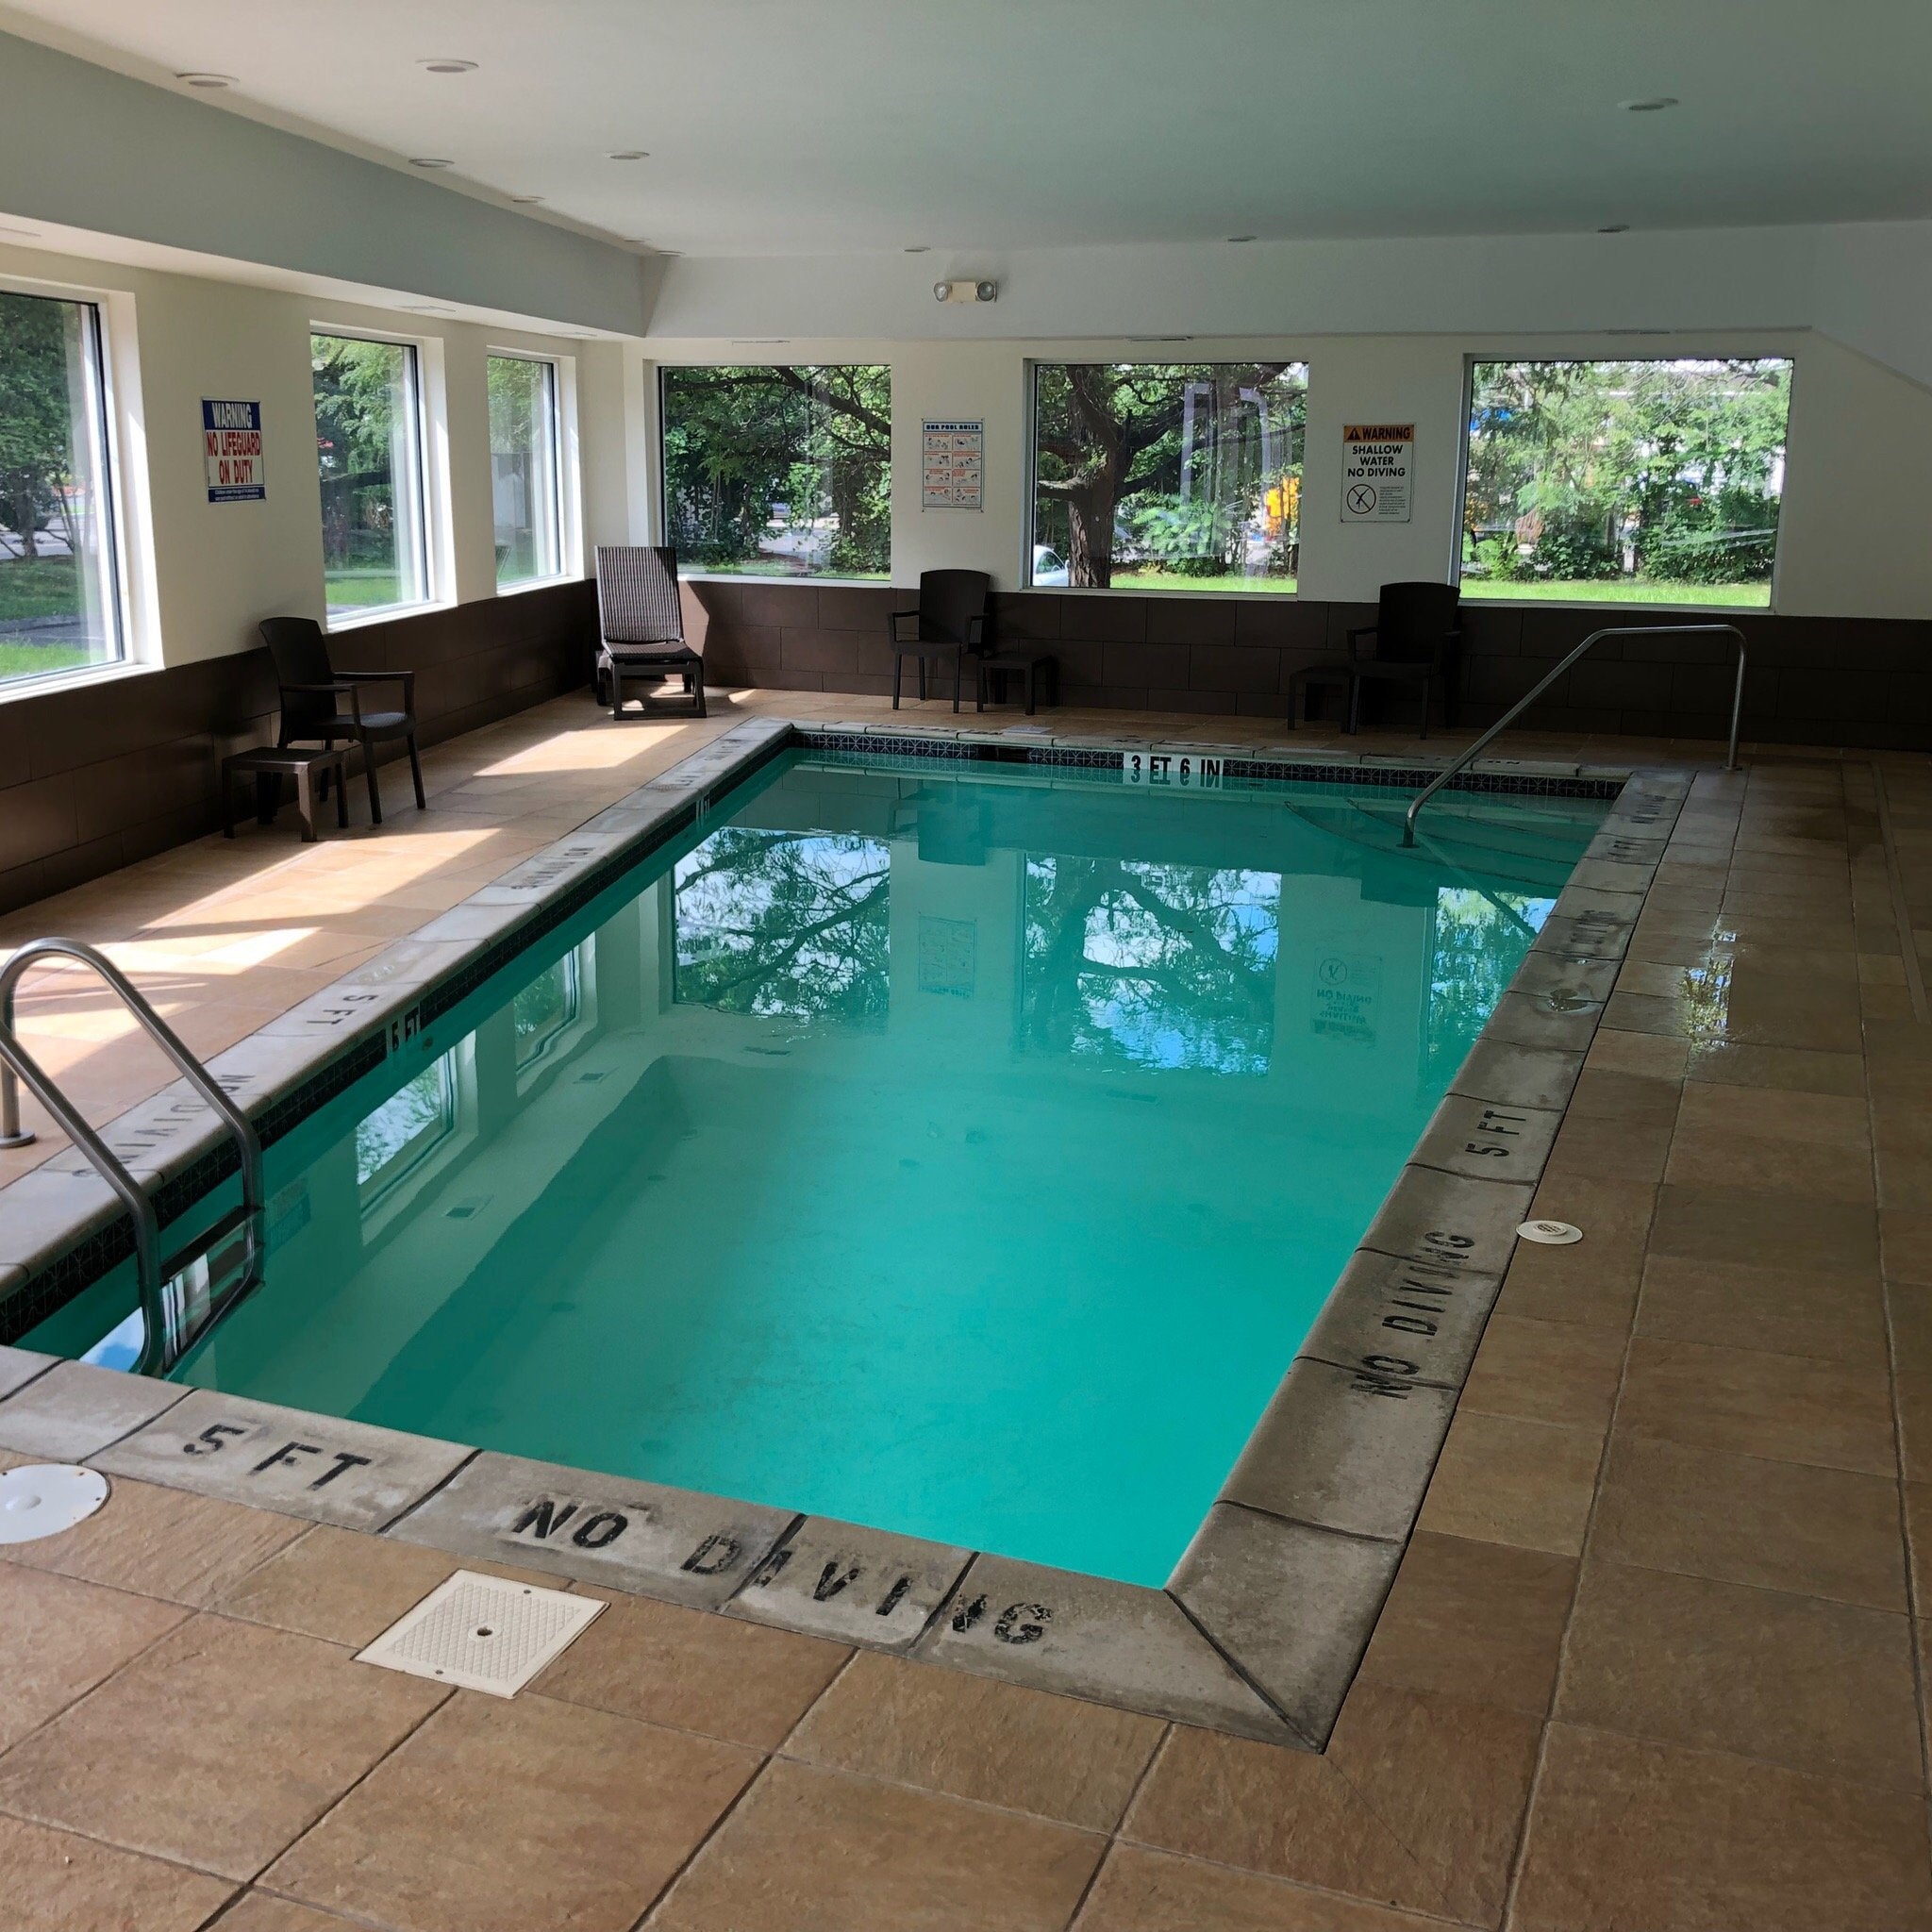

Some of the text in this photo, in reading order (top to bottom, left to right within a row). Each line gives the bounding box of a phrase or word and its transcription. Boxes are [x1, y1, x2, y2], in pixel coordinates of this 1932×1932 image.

[211, 402, 253, 428] WARNING
[207, 432, 260, 457] NO LIFEGUARD
[1362, 426, 1411, 441] WARNING
[1352, 444, 1403, 454] SHALLOW
[1359, 457, 1394, 466] WATER
[219, 459, 253, 484] ON DUTY
[1347, 467, 1406, 477] NO DIVING
[307, 994, 379, 1025] 5 FT
[1465, 1109, 1527, 1158] 5 FT
[183, 1424, 373, 1491] 5 FT
[513, 1500, 629, 1550] NO
